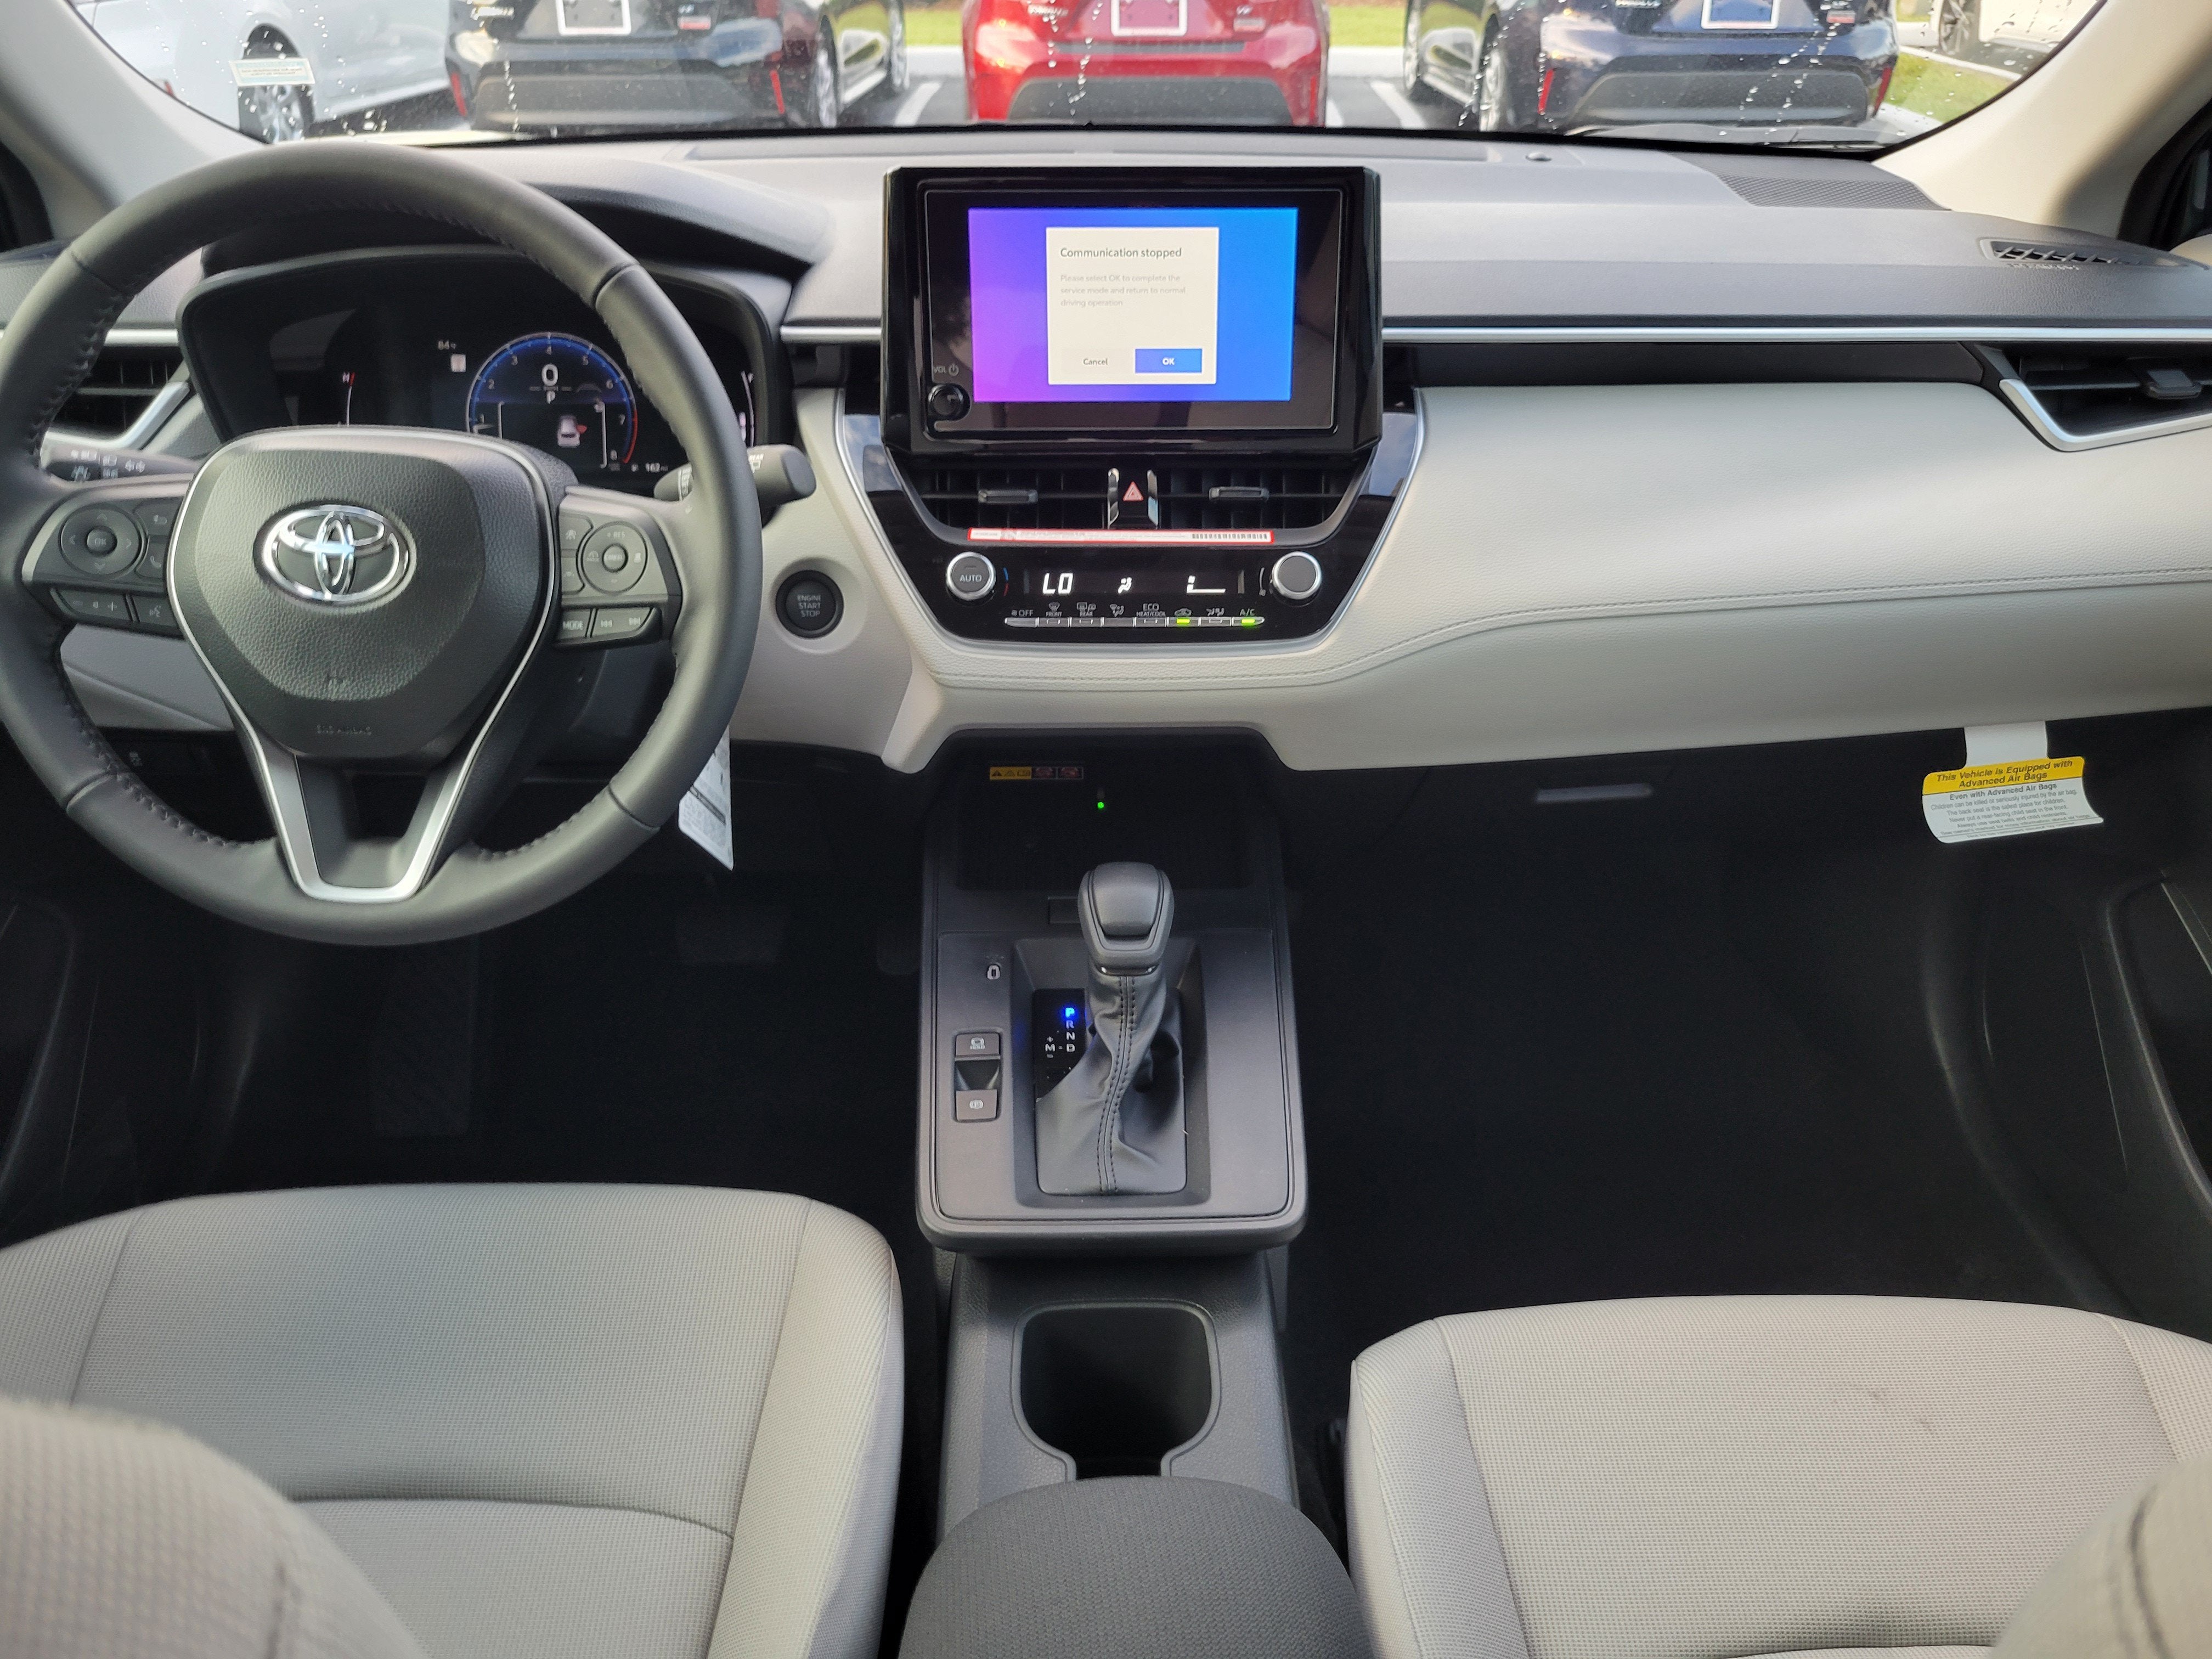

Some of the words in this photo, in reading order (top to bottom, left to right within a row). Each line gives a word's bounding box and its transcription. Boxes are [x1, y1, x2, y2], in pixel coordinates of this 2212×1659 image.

[1060, 247, 1138, 258] Communication
[1141, 247, 1182, 260] stopped
[1132, 274, 1167, 284] complete
[1060, 300, 1086, 308] driving
[1083, 358, 1109, 366] Cancel
[1162, 357, 1175, 366] OK
[541, 363, 559, 386] 0
[960, 574, 983, 583] AUTO
[1042, 572, 1074, 595] LO
[1143, 603, 1159, 611] ECO
[1239, 608, 1255, 616] A/C
[562, 620, 583, 630] MODE
[1937, 773, 1956, 782] This
[1960, 769, 1993, 780] Vehicle
[2006, 762, 2051, 774] Equipped
[2053, 760, 2073, 768] with
[1959, 776, 2005, 788] Advanced
[2008, 774, 2022, 782] Air
[2024, 772, 2047, 781] Bags
[1988, 786, 2024, 796] Advanced
[2038, 783, 2057, 791] Bags
[1996, 795, 2020, 804] seriously
[1065, 1007, 1075, 1018] P
[1065, 1020, 1074, 1029] R
[1066, 1031, 1075, 1040] N
[1045, 1043, 1056, 1052] M
[1066, 1043, 1075, 1052] D
